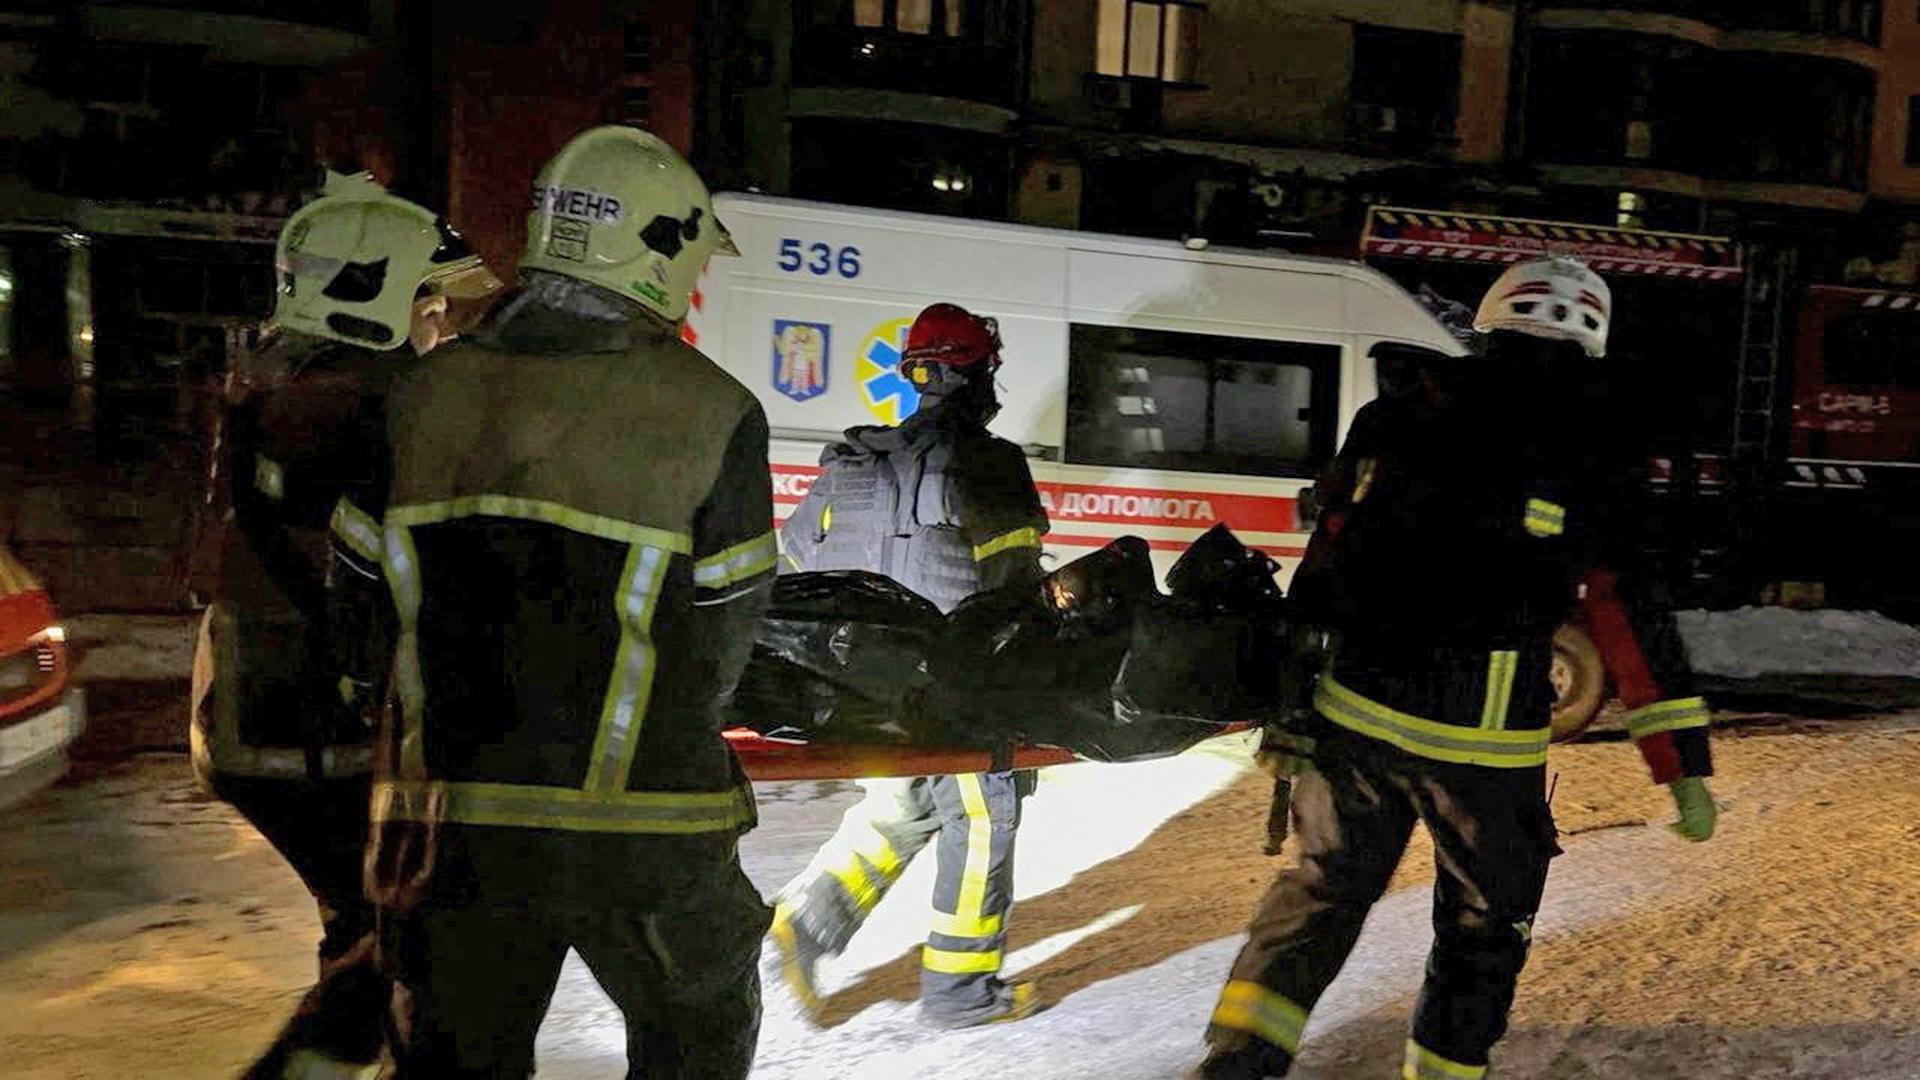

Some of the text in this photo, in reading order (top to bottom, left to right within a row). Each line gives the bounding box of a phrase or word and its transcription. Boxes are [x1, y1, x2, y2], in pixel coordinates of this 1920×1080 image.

[777, 238, 861, 279] 536
[772, 473, 818, 496] КС
[1058, 492, 1216, 521] ДОПОМОГА
